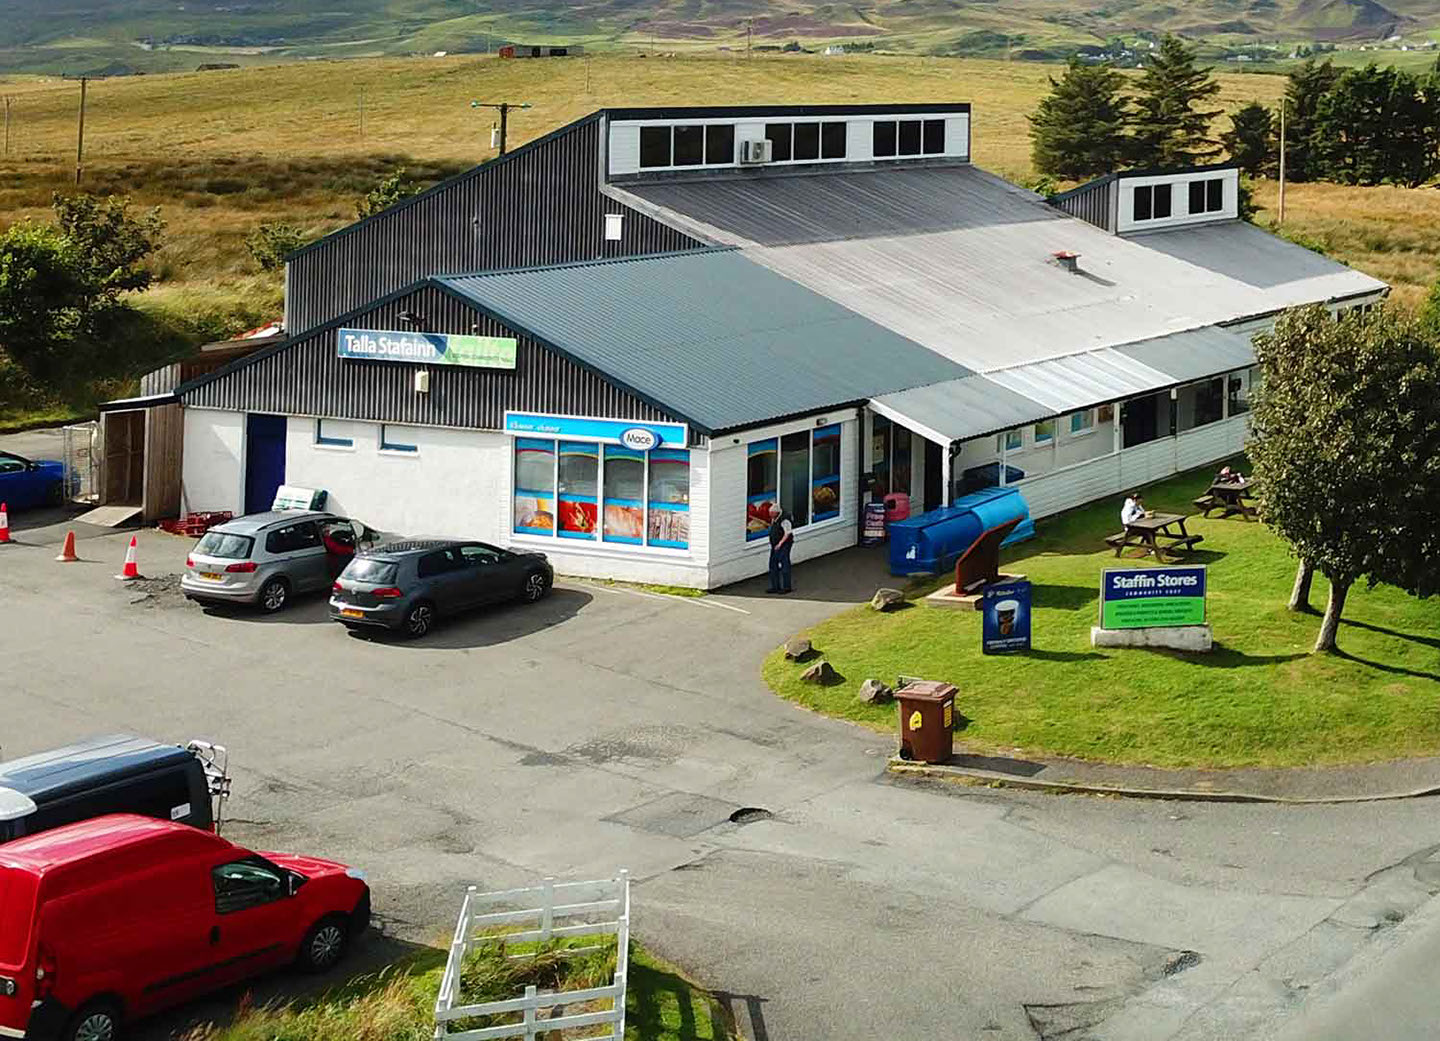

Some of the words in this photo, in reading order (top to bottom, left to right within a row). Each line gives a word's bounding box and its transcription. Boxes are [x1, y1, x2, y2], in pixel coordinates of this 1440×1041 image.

[345, 335, 376, 353] Talla
[626, 433, 652, 445] Mace
[1112, 575, 1155, 589] Staffin
[1157, 574, 1198, 587] Stores
